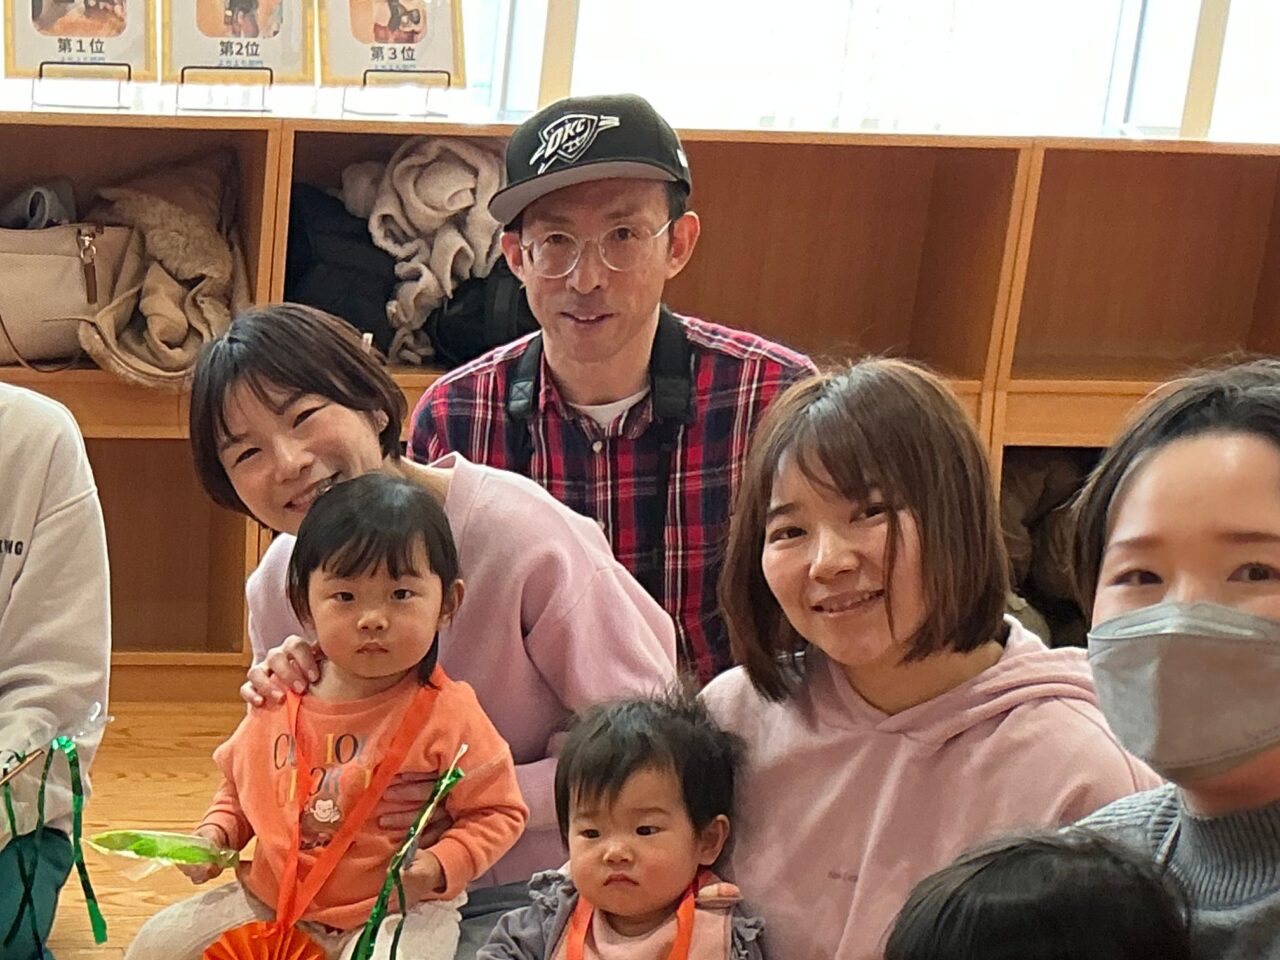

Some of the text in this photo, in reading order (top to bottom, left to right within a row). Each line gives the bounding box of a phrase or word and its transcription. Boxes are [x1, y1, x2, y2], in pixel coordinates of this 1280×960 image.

[57, 38, 105, 54] 第1位
[219, 41, 260, 56] 第2位
[370, 46, 416, 61] 第3位
[544, 118, 586, 158] OKC
